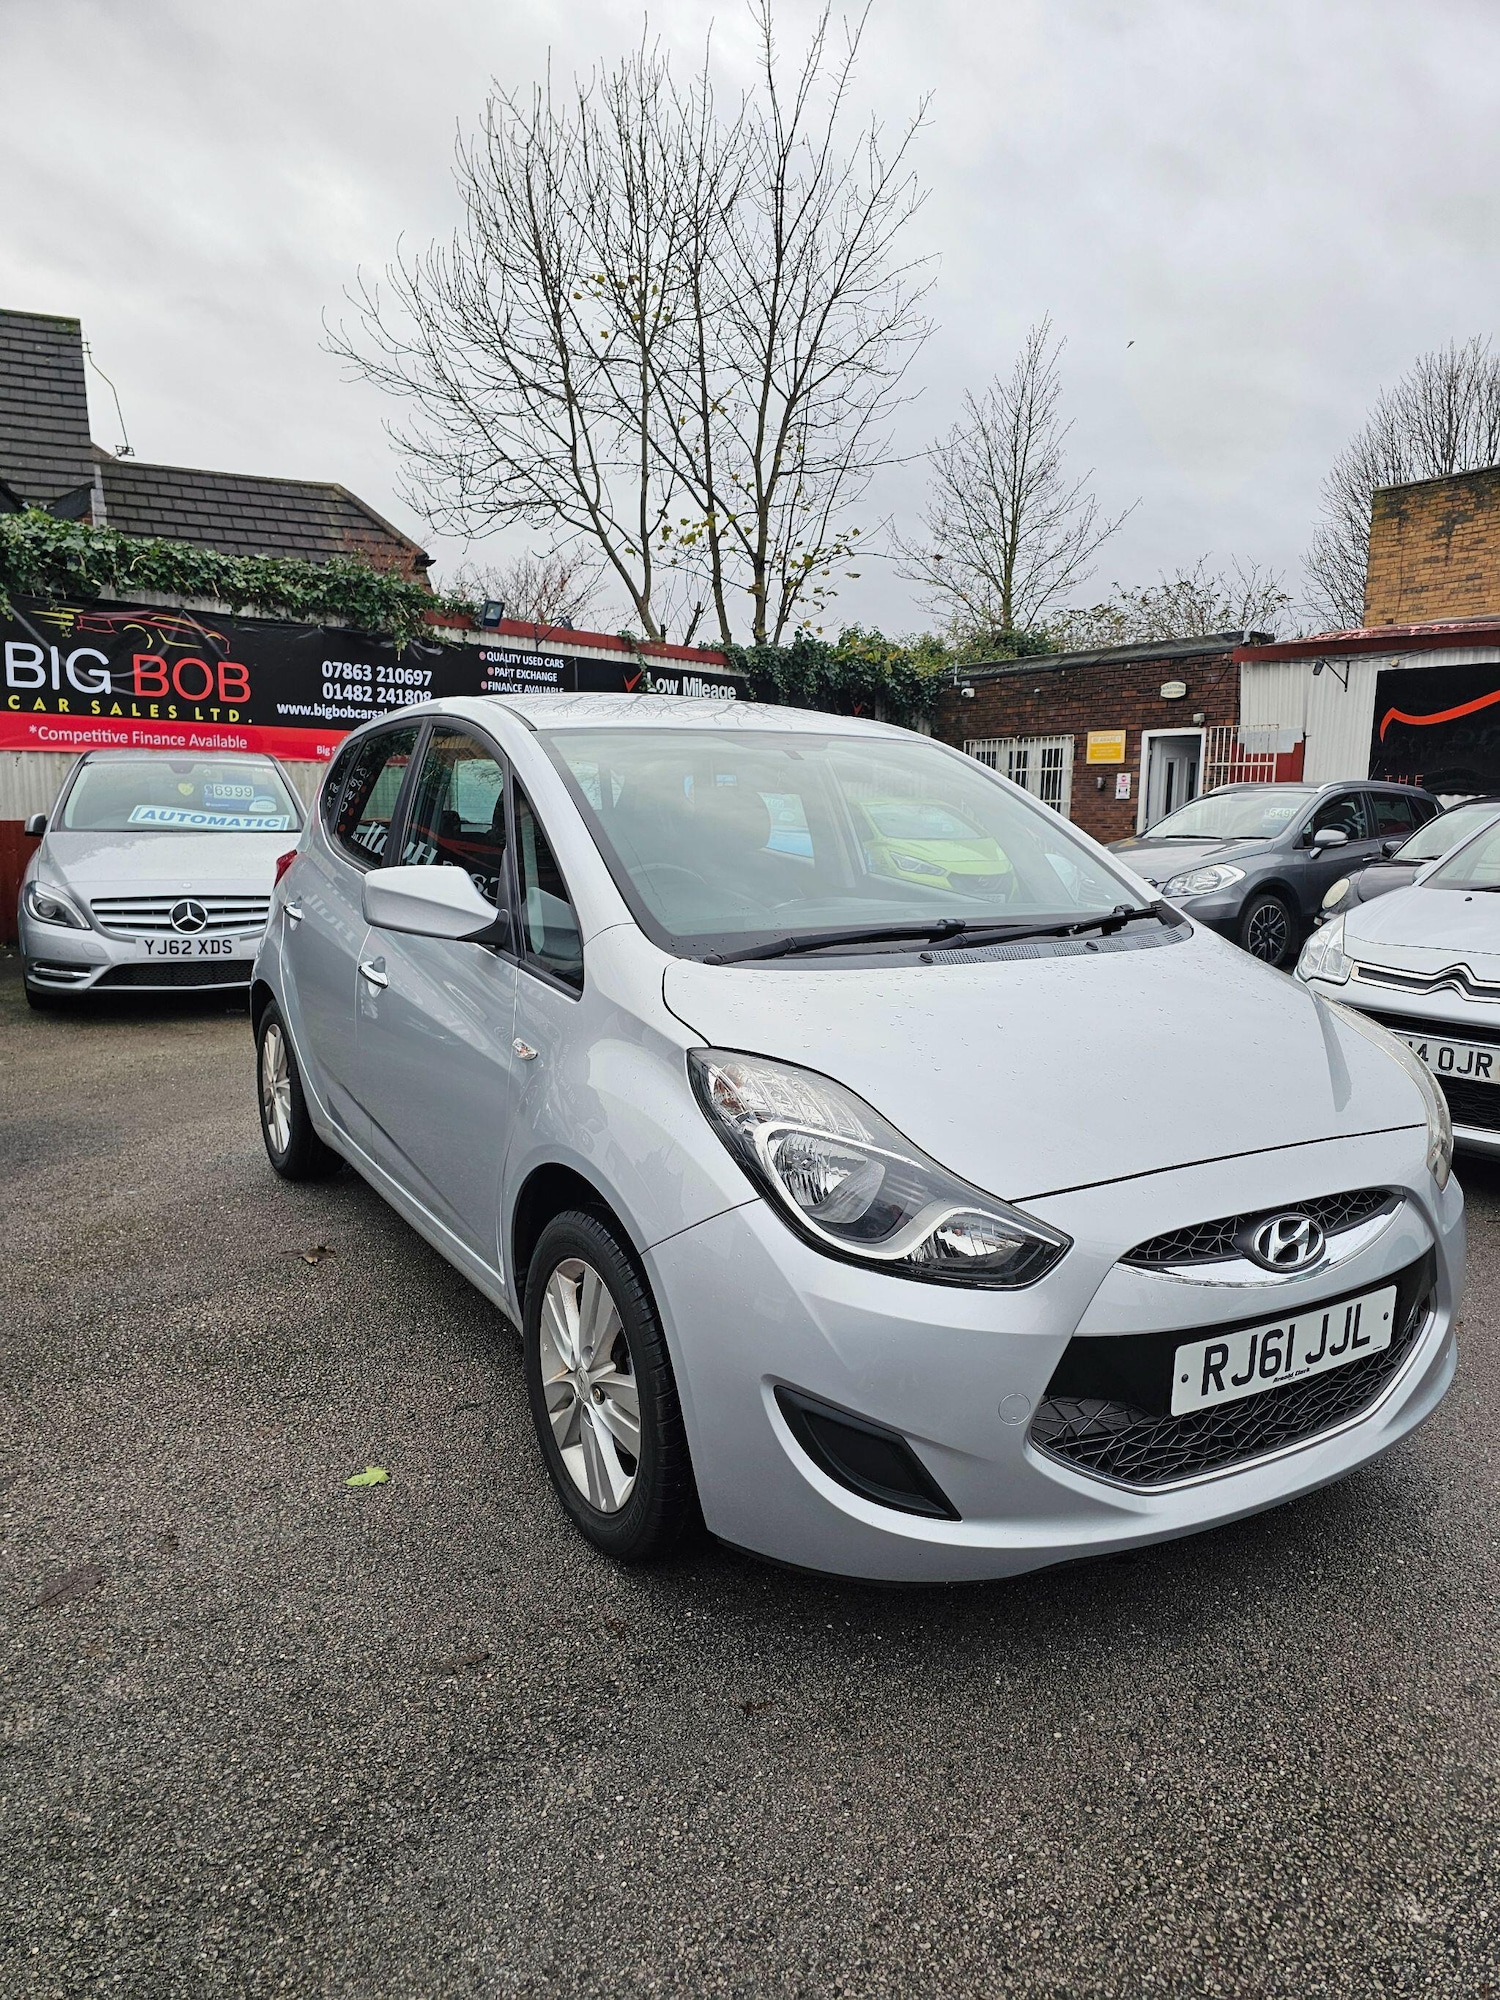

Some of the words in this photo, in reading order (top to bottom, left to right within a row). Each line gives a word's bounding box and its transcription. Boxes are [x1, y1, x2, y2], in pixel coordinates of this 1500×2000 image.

[486, 651, 521, 664] QUALITY
[522, 655, 543, 667] USED
[544, 658, 564, 669] CARS
[4, 641, 112, 694] BIG
[133, 653, 251, 703] BOB
[321, 660, 373, 681] 07863
[376, 666, 433, 687] 210697
[494, 667, 515, 678] PART
[516, 669, 558, 682] EXCHANGE
[322, 682, 373, 702] 01482
[376, 686, 433, 705] 241808
[487, 681, 523, 693] FINANCE
[646, 671, 680, 694] Low
[682, 676, 737, 700] Mileage
[8, 695, 70, 712] CAR
[90, 700, 178, 719] SALES
[195, 707, 253, 724] LTD.
[132, 731, 186, 746] Finance
[189, 734, 248, 749] Available
[316, 745, 331, 757] Big
[1384, 775, 1425, 787] THE
[141, 809, 280, 828] AUTOMATIC
[144, 940, 192, 955] YJ62
[198, 939, 232, 955] XDS
[1437, 1046, 1494, 1079] OJR
[1200, 1323, 1296, 1397] RJ61
[1304, 1303, 1371, 1365] JJL
